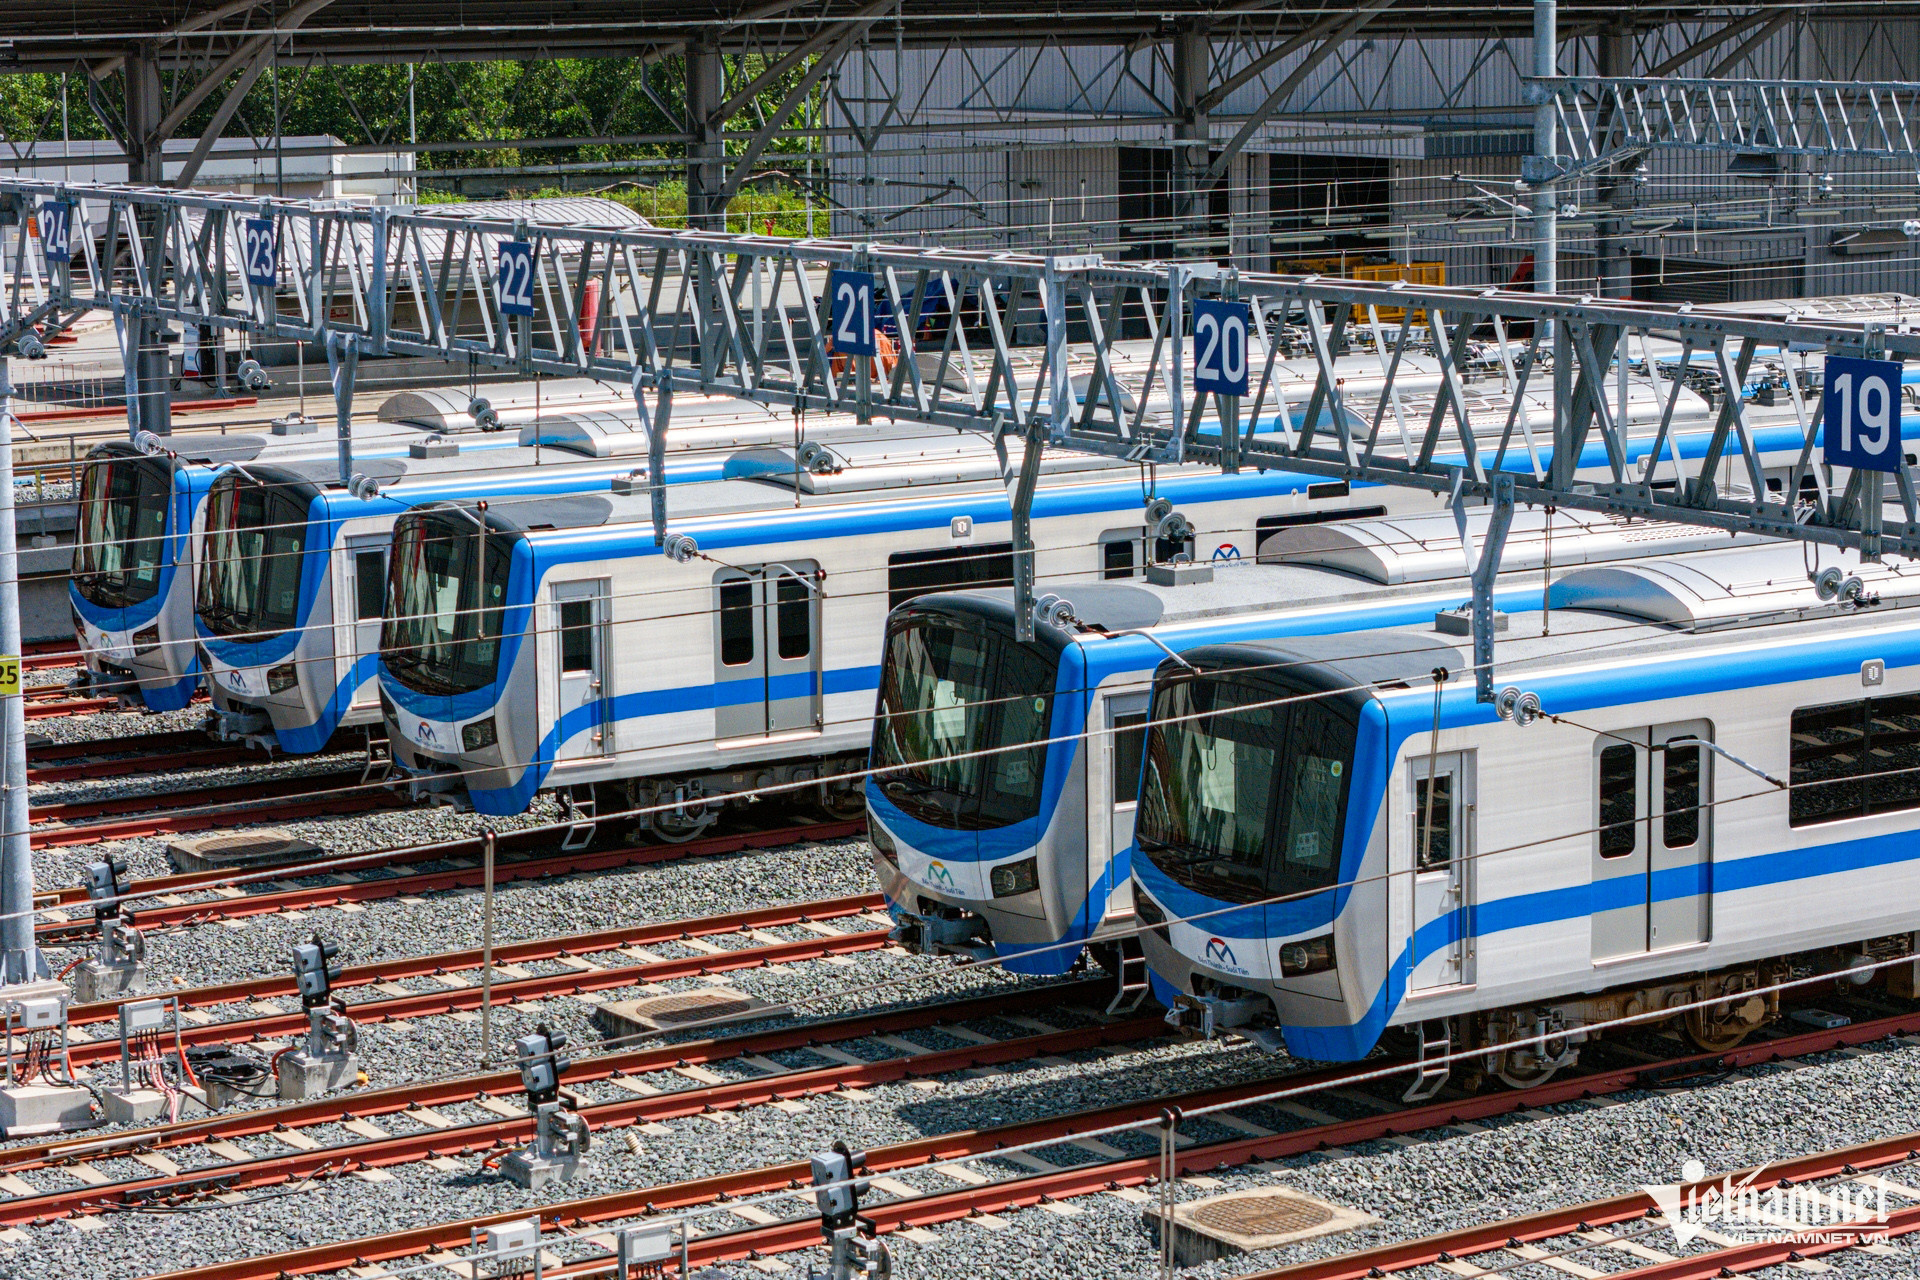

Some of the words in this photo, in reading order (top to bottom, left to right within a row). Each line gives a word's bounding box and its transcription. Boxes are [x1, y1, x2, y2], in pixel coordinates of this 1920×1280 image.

[45, 210, 68, 254] 24
[248, 229, 274, 278] 23
[500, 251, 532, 307] 22
[837, 282, 870, 345] 21
[1196, 313, 1246, 383] 20
[1834, 373, 1891, 456] 19
